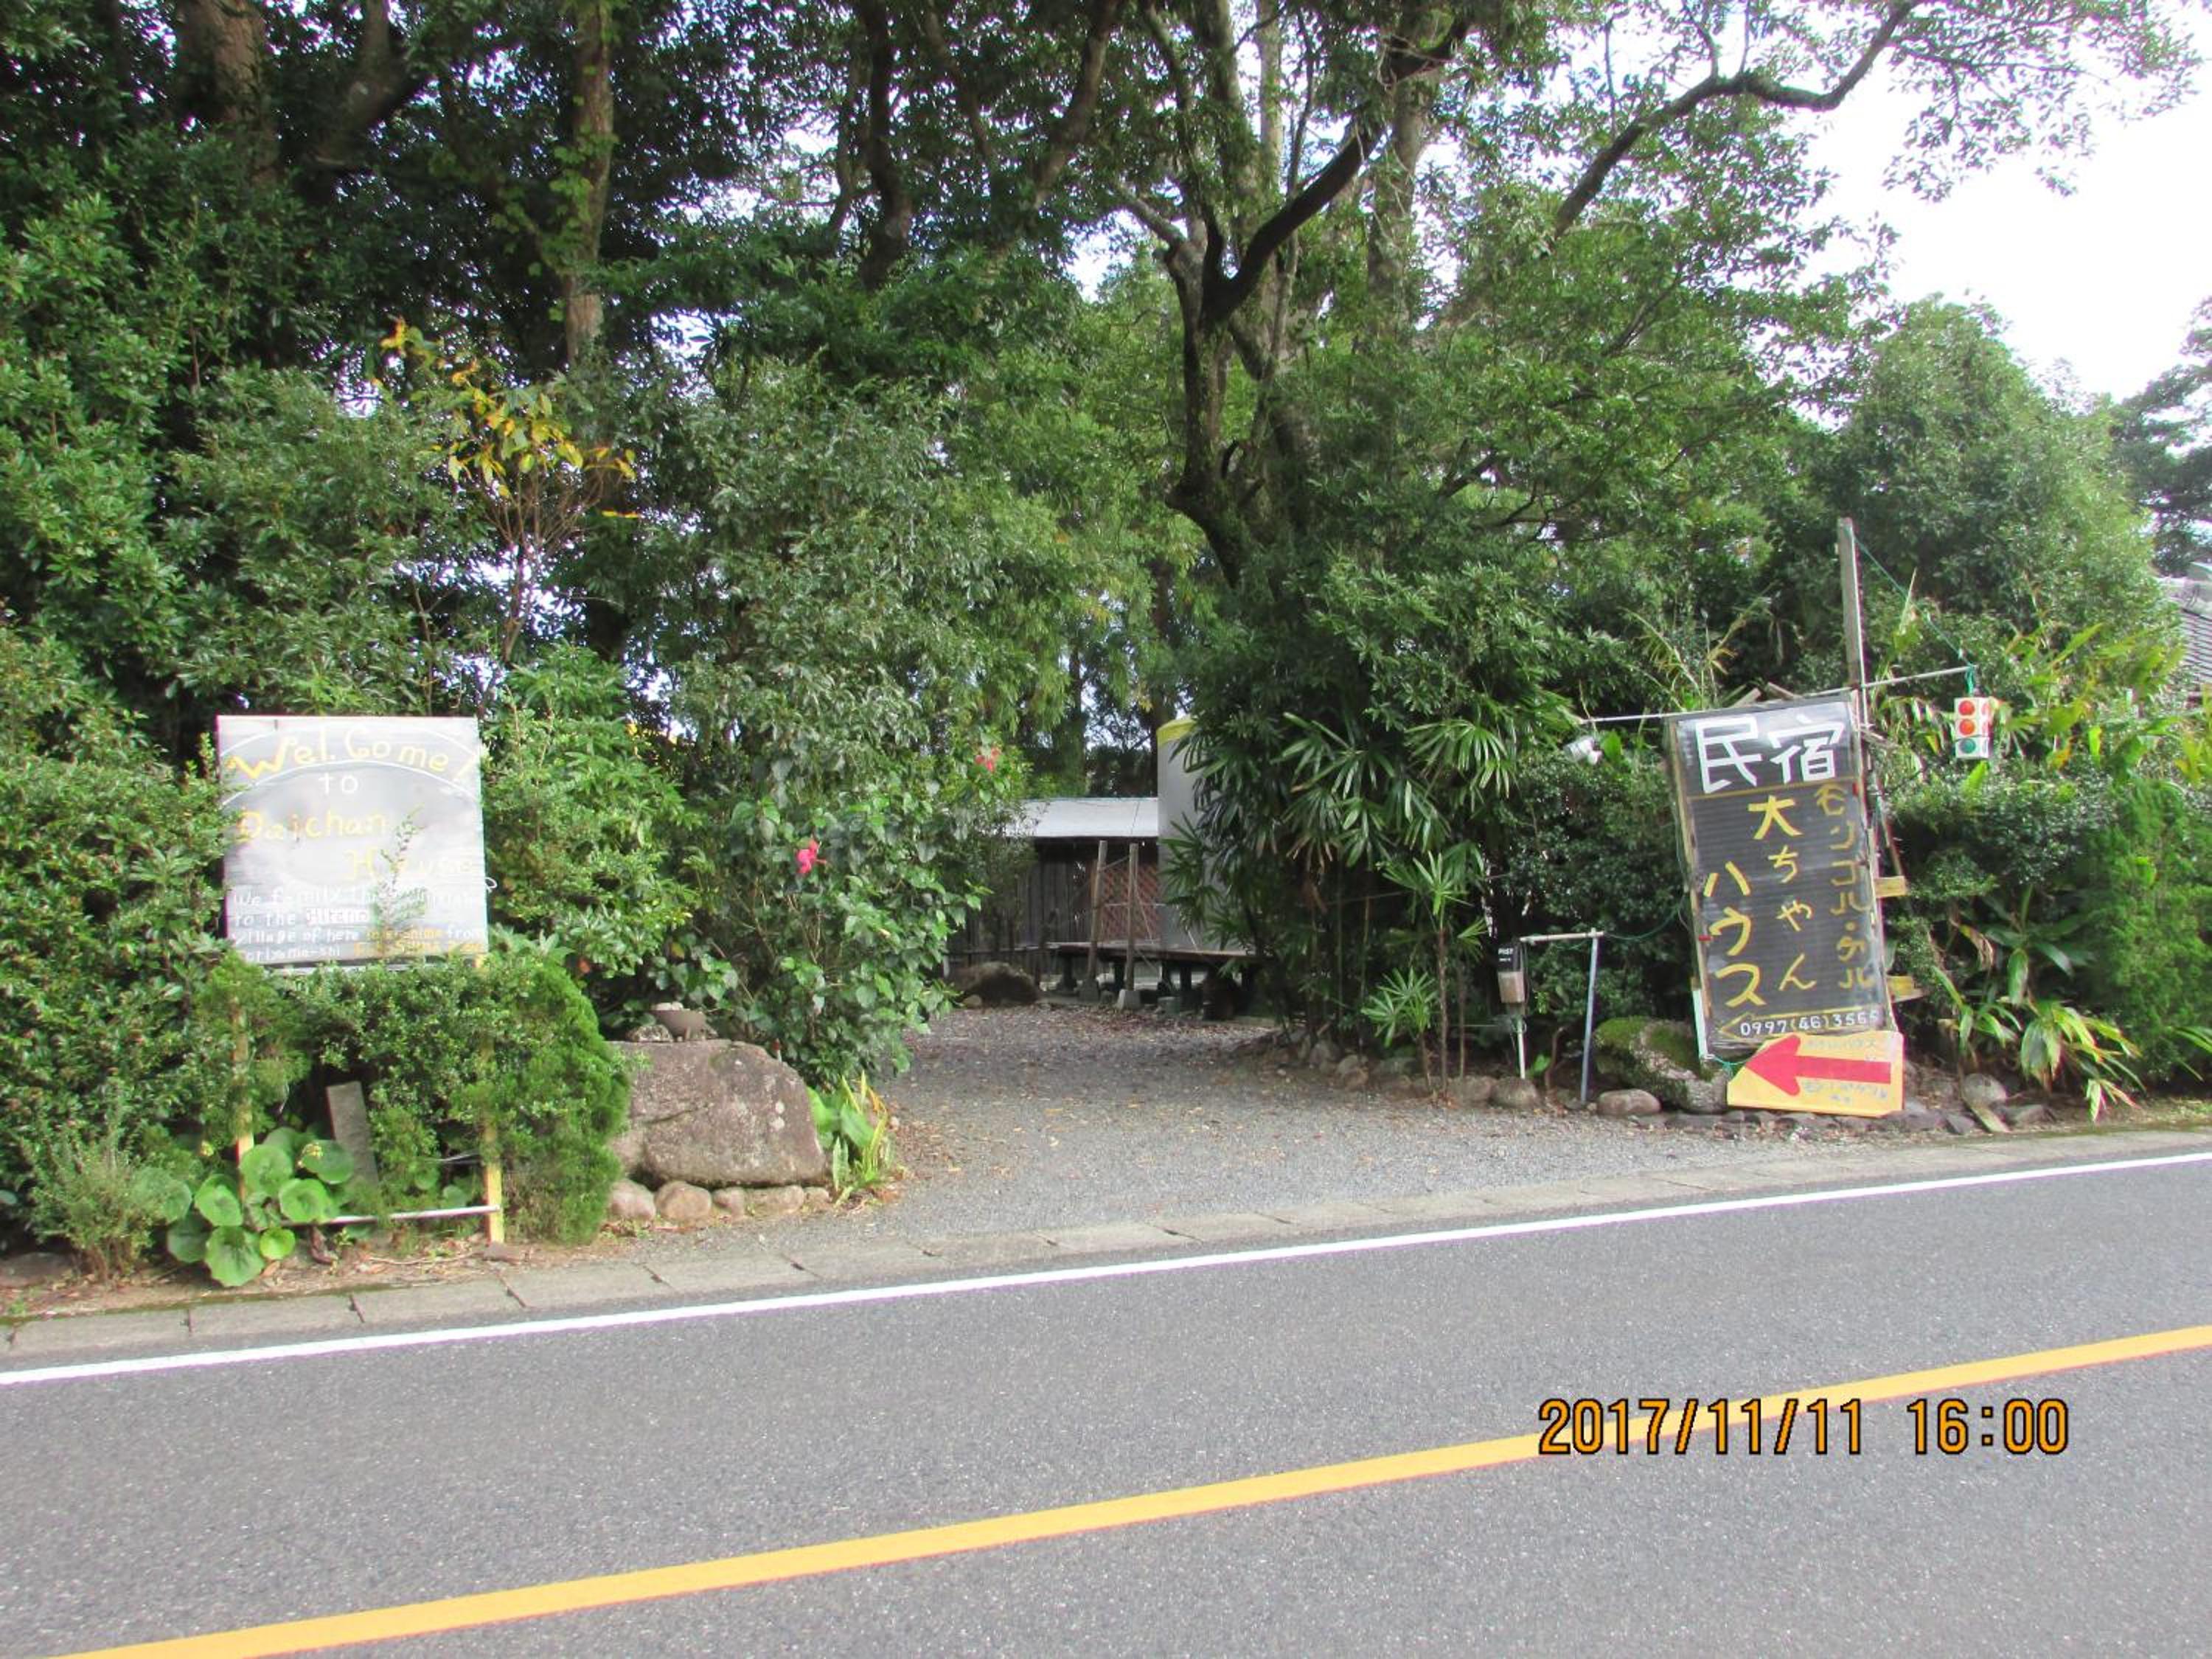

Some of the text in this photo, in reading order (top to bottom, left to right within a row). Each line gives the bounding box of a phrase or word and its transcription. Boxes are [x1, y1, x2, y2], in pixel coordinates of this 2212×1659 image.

[1695, 713, 1845, 793] 民宿
[1703, 861, 1767, 1008] ハウス
[1747, 795, 1818, 991] 大ちゃん
